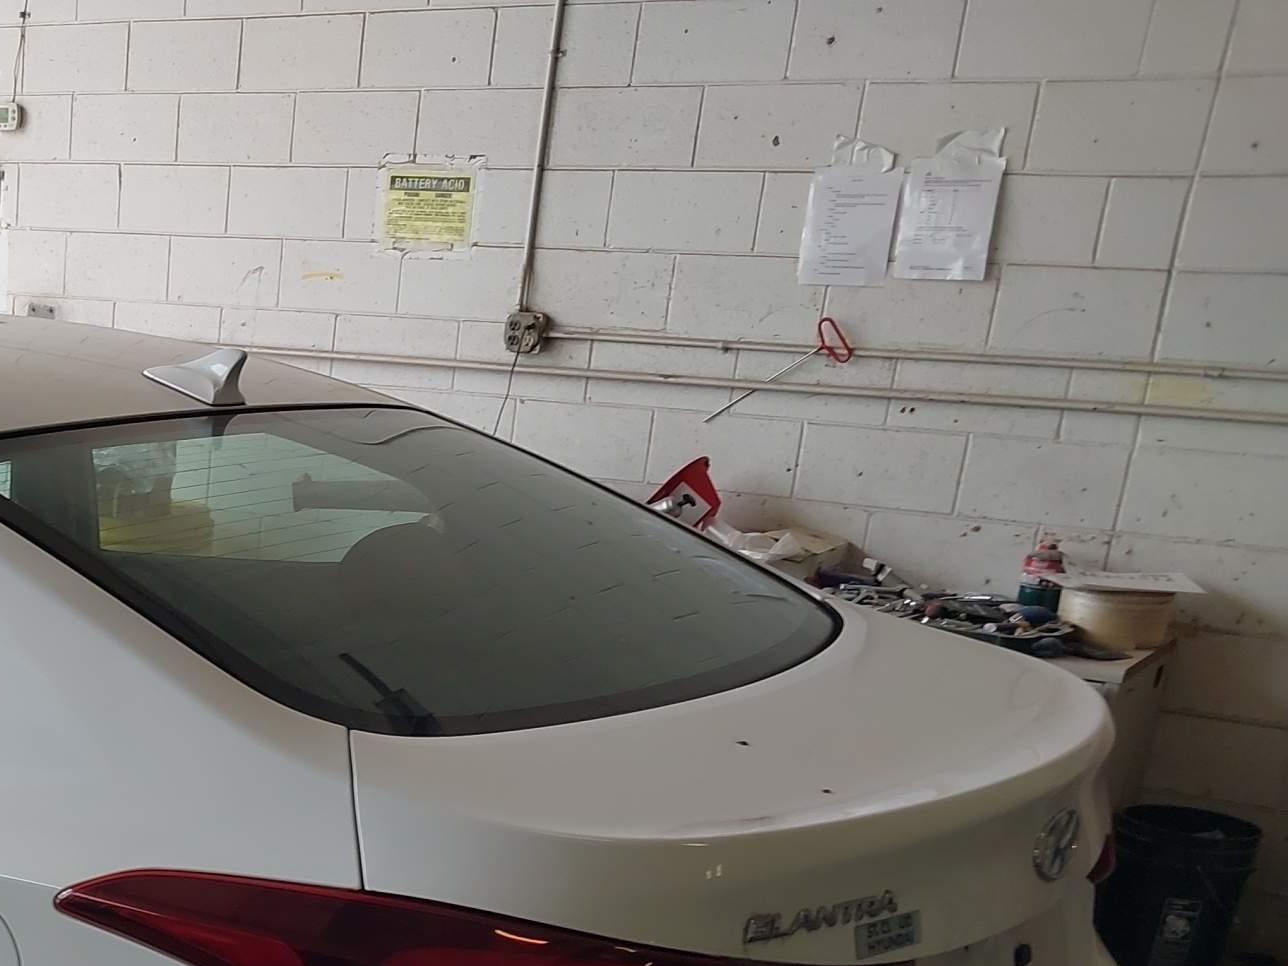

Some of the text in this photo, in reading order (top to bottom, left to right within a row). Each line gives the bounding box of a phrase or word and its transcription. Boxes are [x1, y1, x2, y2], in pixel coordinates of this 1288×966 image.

[394, 177, 465, 191] BATTERY ACID
[743, 889, 898, 943] ELANTRA
